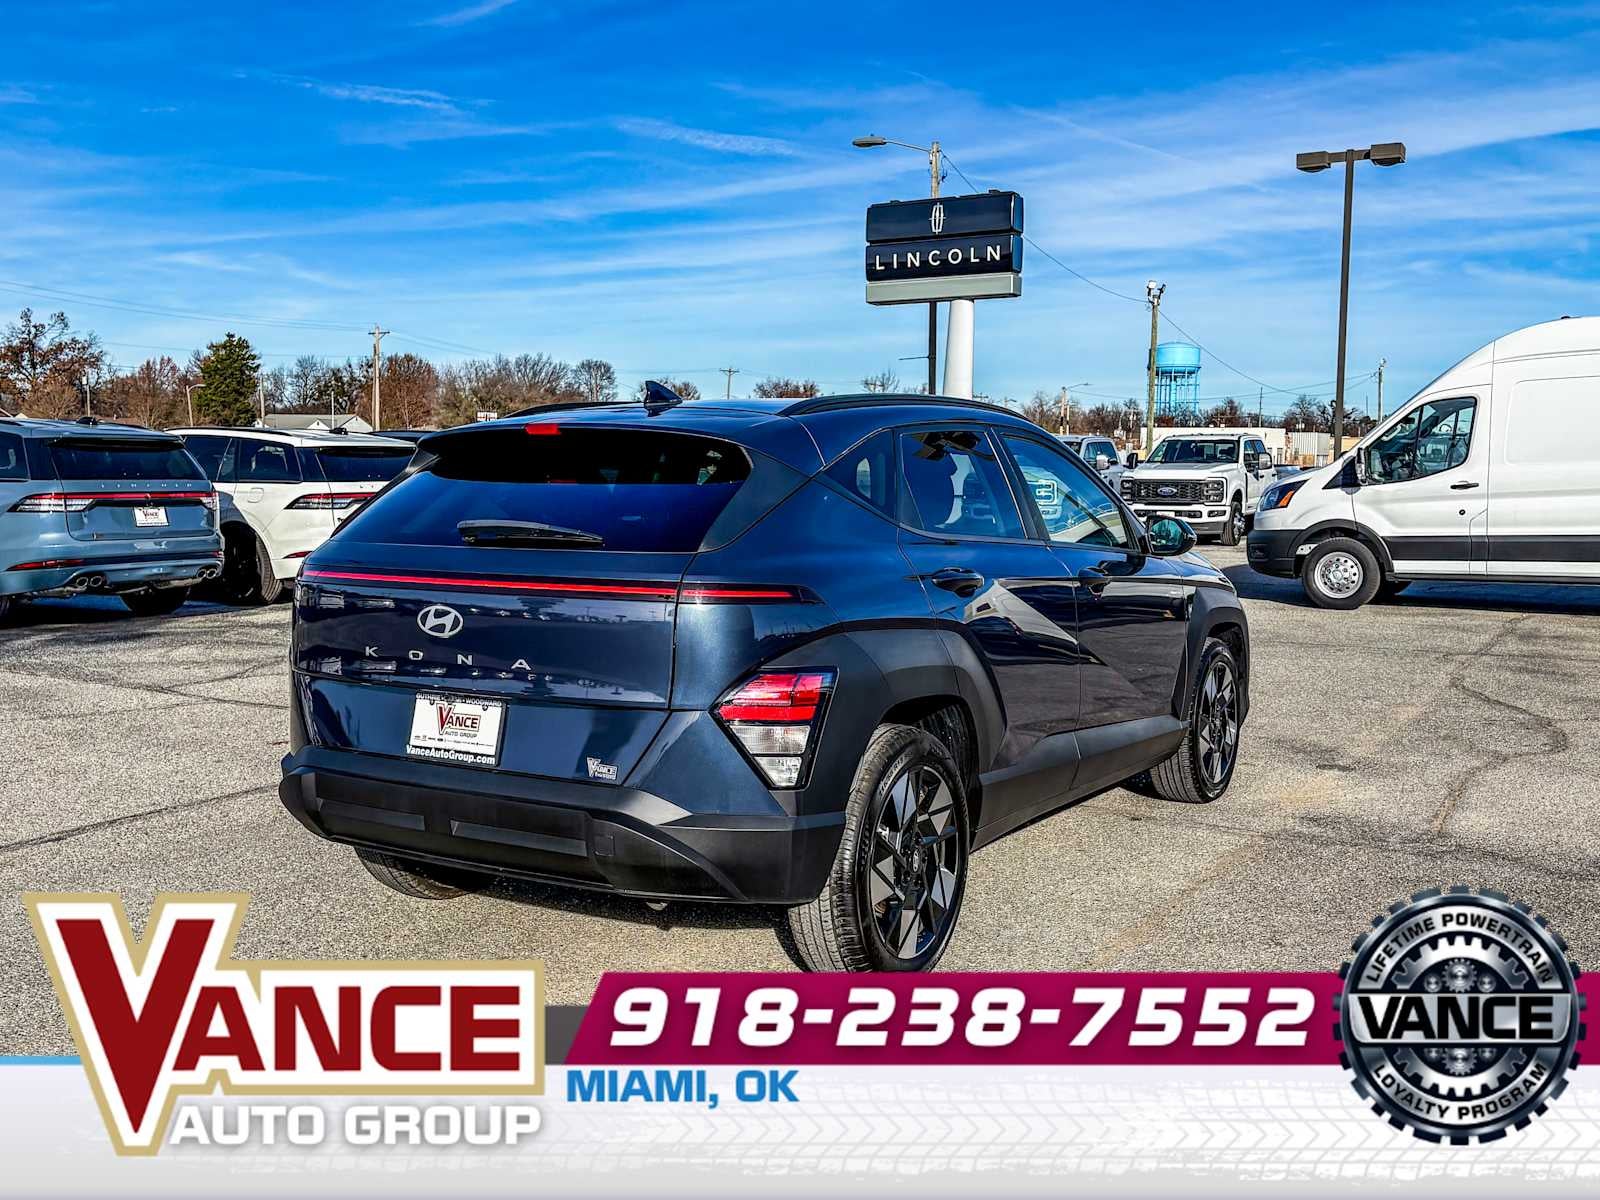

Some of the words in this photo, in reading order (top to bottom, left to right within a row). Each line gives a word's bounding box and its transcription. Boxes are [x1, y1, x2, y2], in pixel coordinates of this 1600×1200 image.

[875, 245, 1001, 271] LINCOLN
[365, 646, 531, 670] KONA
[437, 703, 479, 732] VANCE
[406, 744, 496, 765] VanceAutoGroup.com
